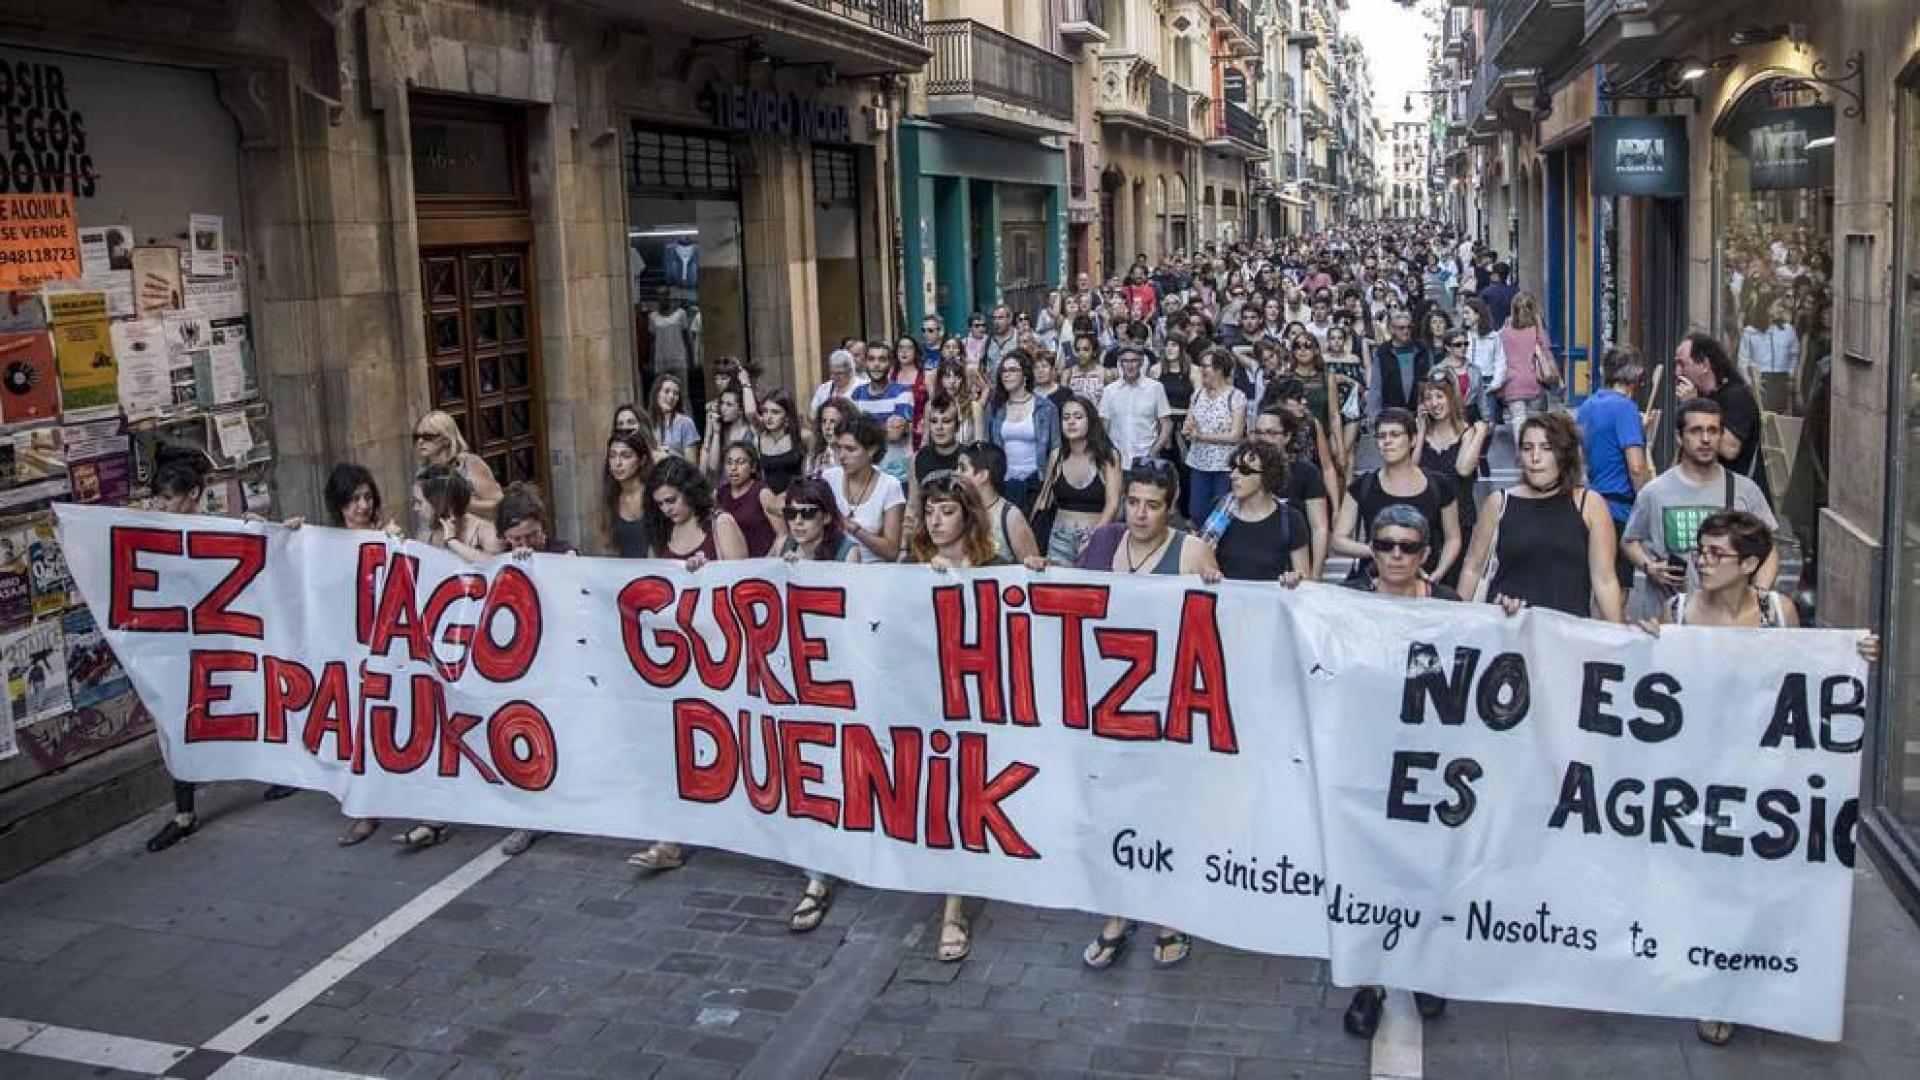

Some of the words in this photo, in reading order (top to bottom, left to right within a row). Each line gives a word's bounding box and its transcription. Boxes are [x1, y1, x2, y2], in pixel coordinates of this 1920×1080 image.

[0, 107, 85, 154] EGOS
[712, 88, 793, 134] TIEMPO
[800, 103, 850, 142] MODA
[1, 226, 18, 240] SE
[20, 225, 68, 239] VENDE
[11, 198, 70, 219] ALQUILA
[109, 526, 267, 640] EZ
[617, 574, 856, 710] GURE
[1399, 641, 1531, 731] NO
[1578, 660, 1684, 743] ES
[1760, 672, 1866, 754] AB
[1386, 750, 1484, 827] ES
[1112, 828, 1174, 873] Guk
[1465, 899, 1598, 951] Nosotras
[1629, 920, 1658, 959] te
[1687, 945, 1799, 973] creemos
